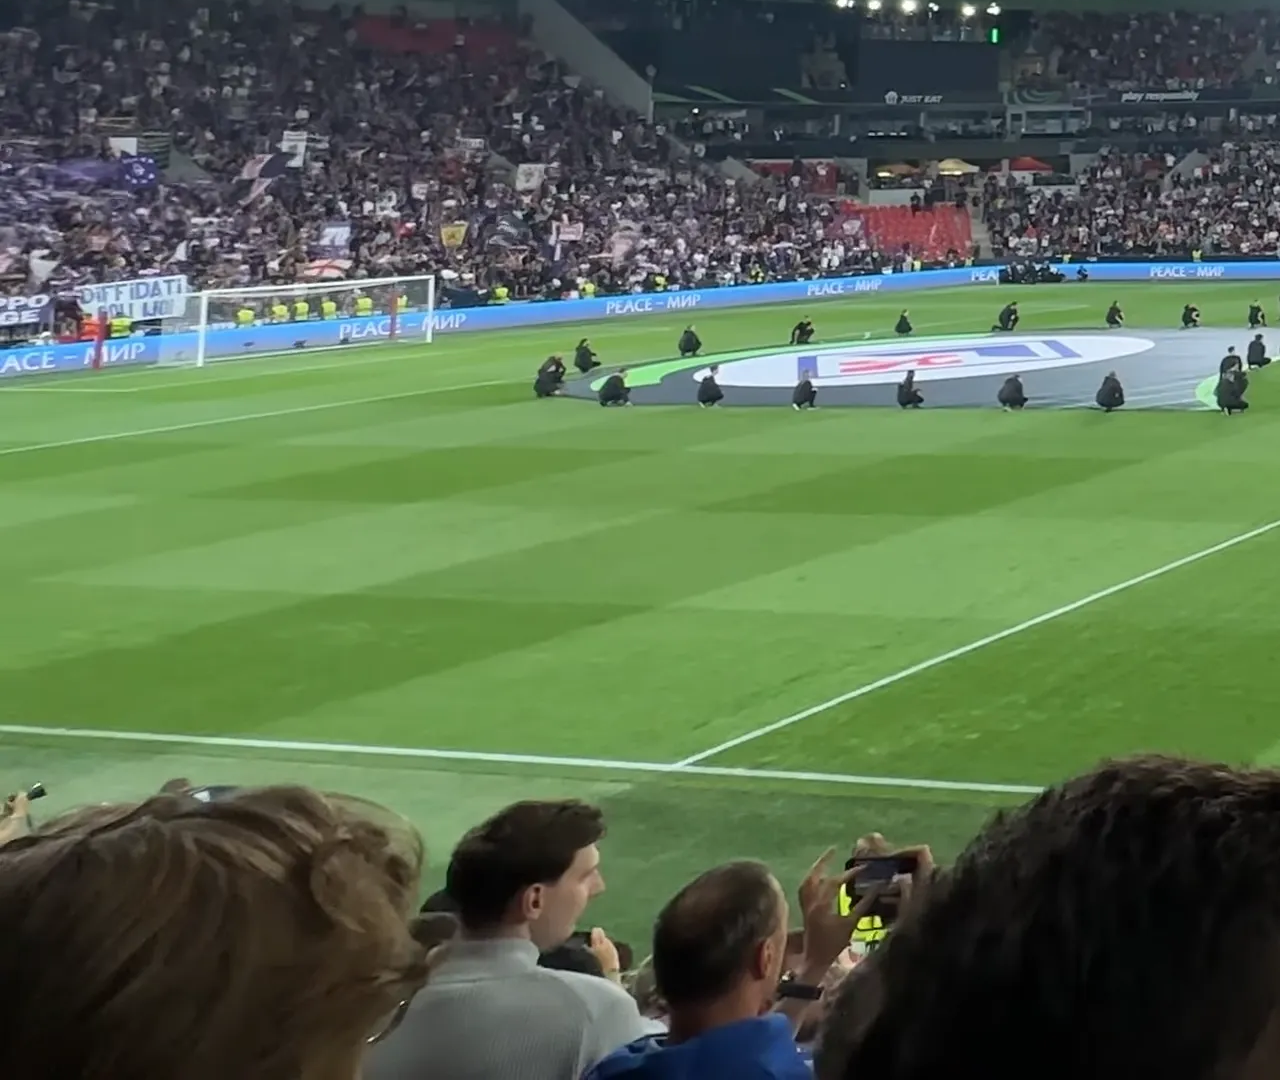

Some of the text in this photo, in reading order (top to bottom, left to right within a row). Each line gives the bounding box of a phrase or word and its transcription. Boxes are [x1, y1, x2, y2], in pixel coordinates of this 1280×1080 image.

[900, 95, 943, 104] JUST EAT
[1150, 265, 1187, 277] PEACE
[807, 281, 844, 296] PEACE
[606, 298, 653, 315] PEACE
[667, 294, 701, 308] МИР
[0, 351, 57, 372] ACE
